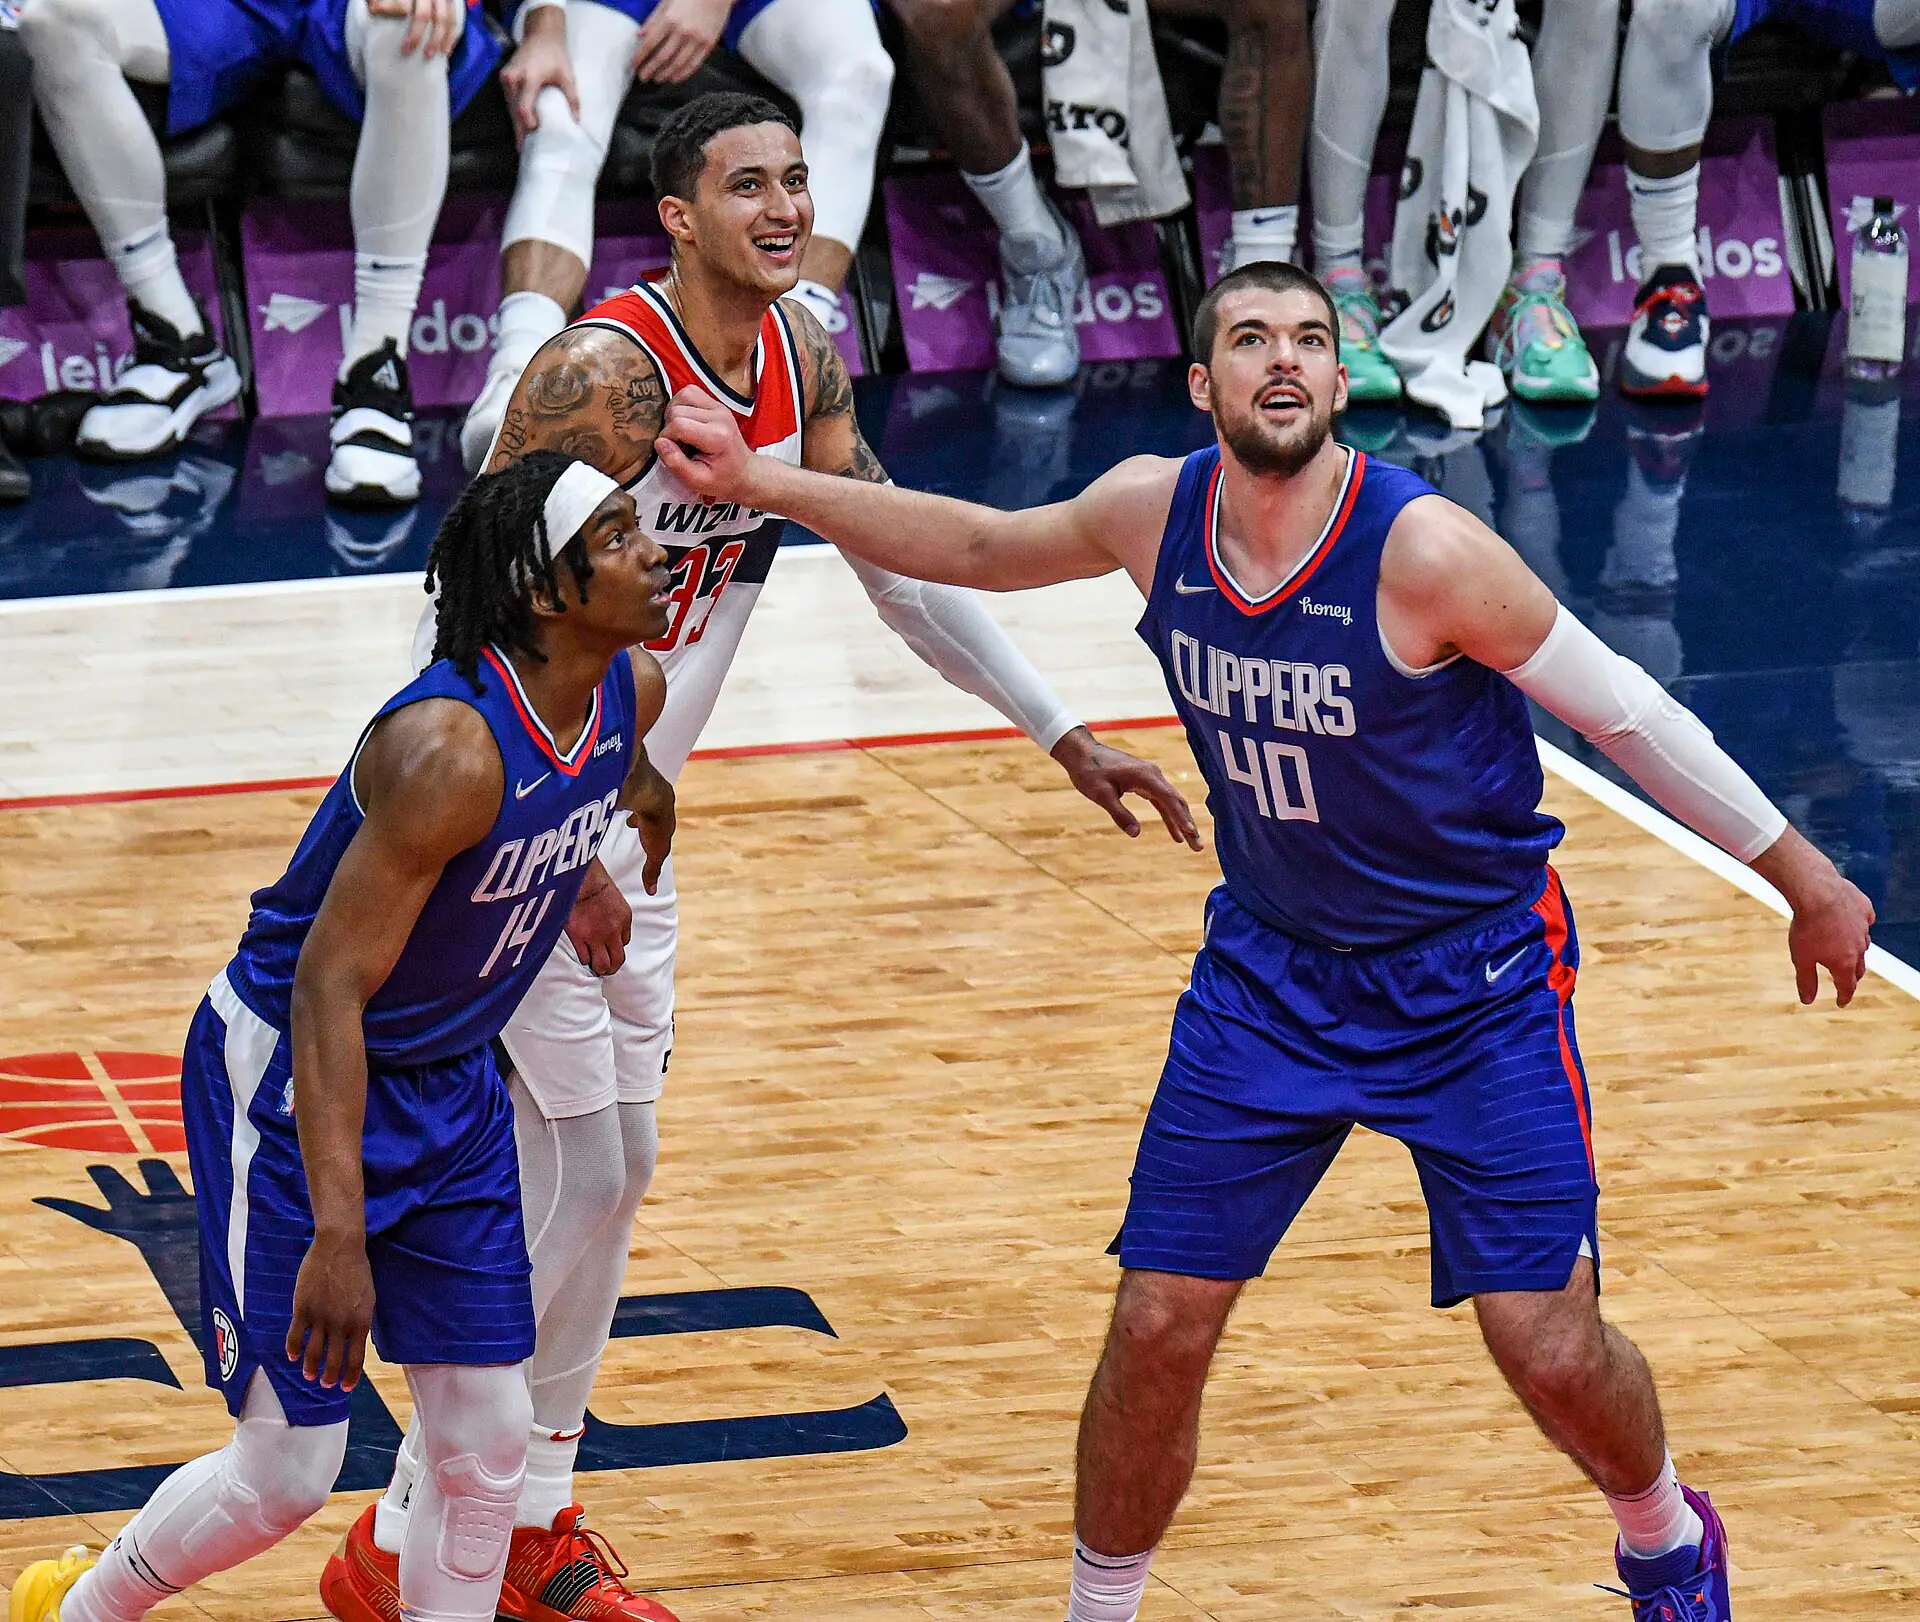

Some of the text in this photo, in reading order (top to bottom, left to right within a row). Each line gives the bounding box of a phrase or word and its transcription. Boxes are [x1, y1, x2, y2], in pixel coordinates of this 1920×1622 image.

[1607, 225, 1783, 283] ldos
[1299, 597, 1354, 626] honey
[1171, 628, 1357, 738] CLIPPERS
[593, 732, 623, 759] honey
[1218, 729, 1320, 824] 40
[470, 787, 619, 903] CLIPPERS
[478, 889, 556, 979] 14
